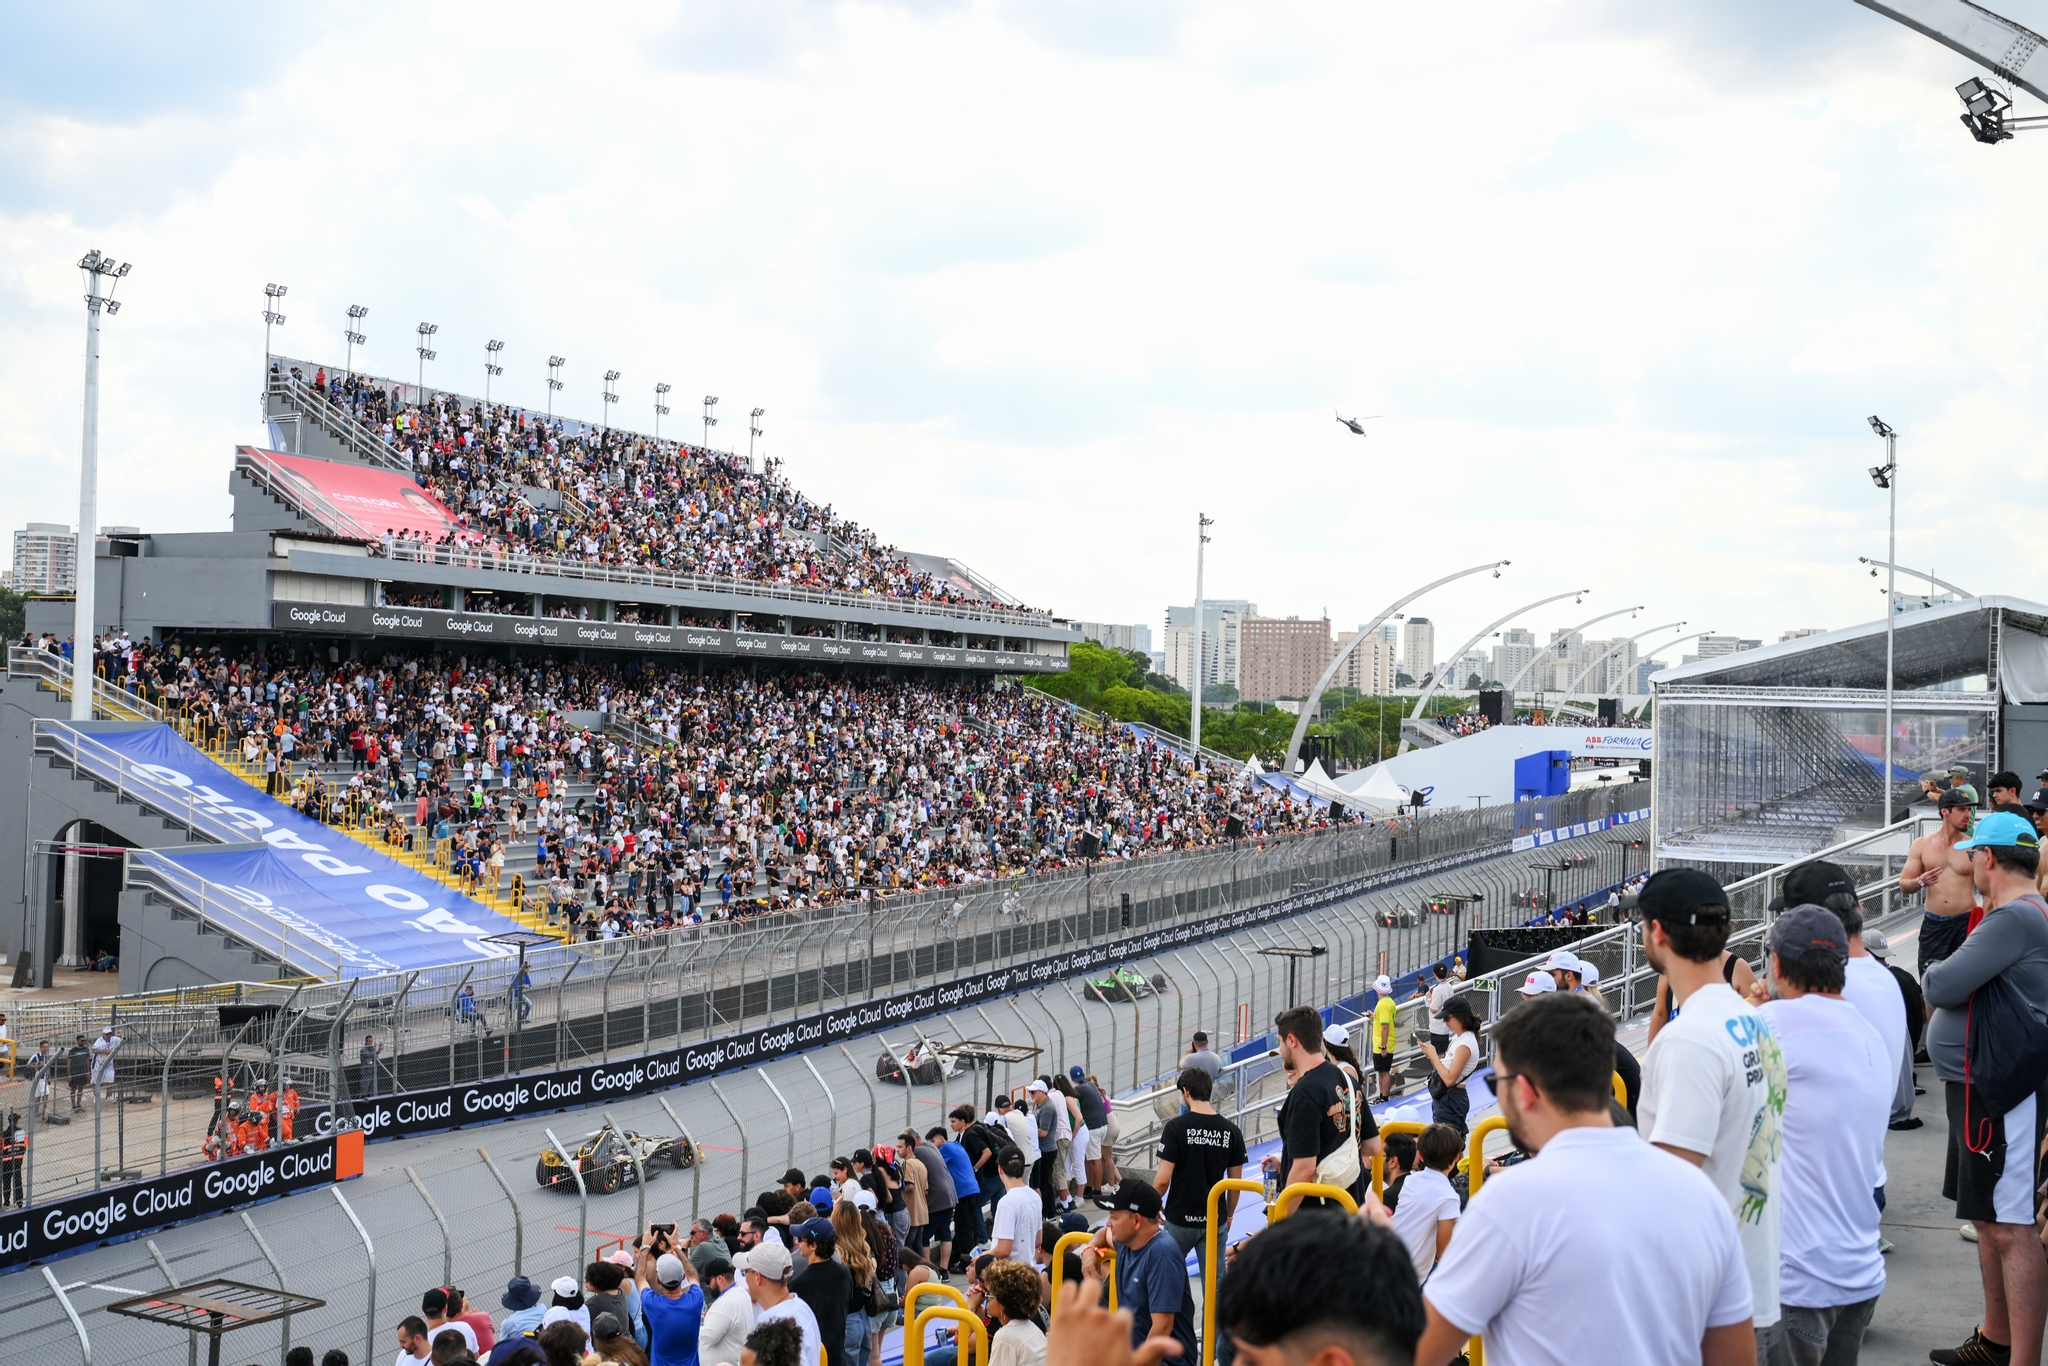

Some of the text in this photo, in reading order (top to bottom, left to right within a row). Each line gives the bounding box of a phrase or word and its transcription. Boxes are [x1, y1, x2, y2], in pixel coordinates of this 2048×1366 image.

[290, 608, 345, 624] Google Cloud
[373, 613, 422, 629] Google Cloud
[447, 618, 492, 633] Google Cloud
[515, 623, 557, 637] Google Cloud
[578, 627, 616, 641] Google Cloud
[635, 631, 670, 644] Google Cloud
[688, 635, 720, 647] Google Cloud
[737, 639, 753, 650] Google
[782, 643, 797, 652] Google
[824, 646, 838, 655] Google
[863, 648, 876, 658] Google
[899, 651, 912, 660] Google
[934, 653, 945, 662] Google
[1585, 736, 1602, 744] ABB
[1602, 735, 1642, 746] FORMULA
[1175, 925, 1203, 942] Google Cloud
[1205, 917, 1230, 934] Google Cloud
[278, 906, 402, 970] WORLD CHAMPIONSHIP
[1144, 931, 1173, 949] Google Cloud
[1109, 939, 1141, 959] Google Cloud
[1072, 948, 1106, 969] Google Cloud
[1031, 957, 1068, 979] Google Cloud
[938, 979, 983, 1004] Google Cloud
[885, 991, 934, 1018] Google Cloud
[827, 1005, 881, 1033] Google Cloud
[760, 1020, 821, 1051] Google Cloud
[686, 1037, 754, 1070] Google Cloud
[592, 1056, 679, 1090] Google Cloud
[464, 1075, 581, 1112] Google Cloud
[397, 1096, 450, 1123] Cloud
[1186, 1128, 1222, 1138] FOX BAJA
[1187, 1137, 1221, 1146] REGIONAL
[1222, 1130, 1230, 1149] 2022
[205, 1146, 331, 1199] Google Cloud
[44, 1180, 192, 1240] Google Cloud
